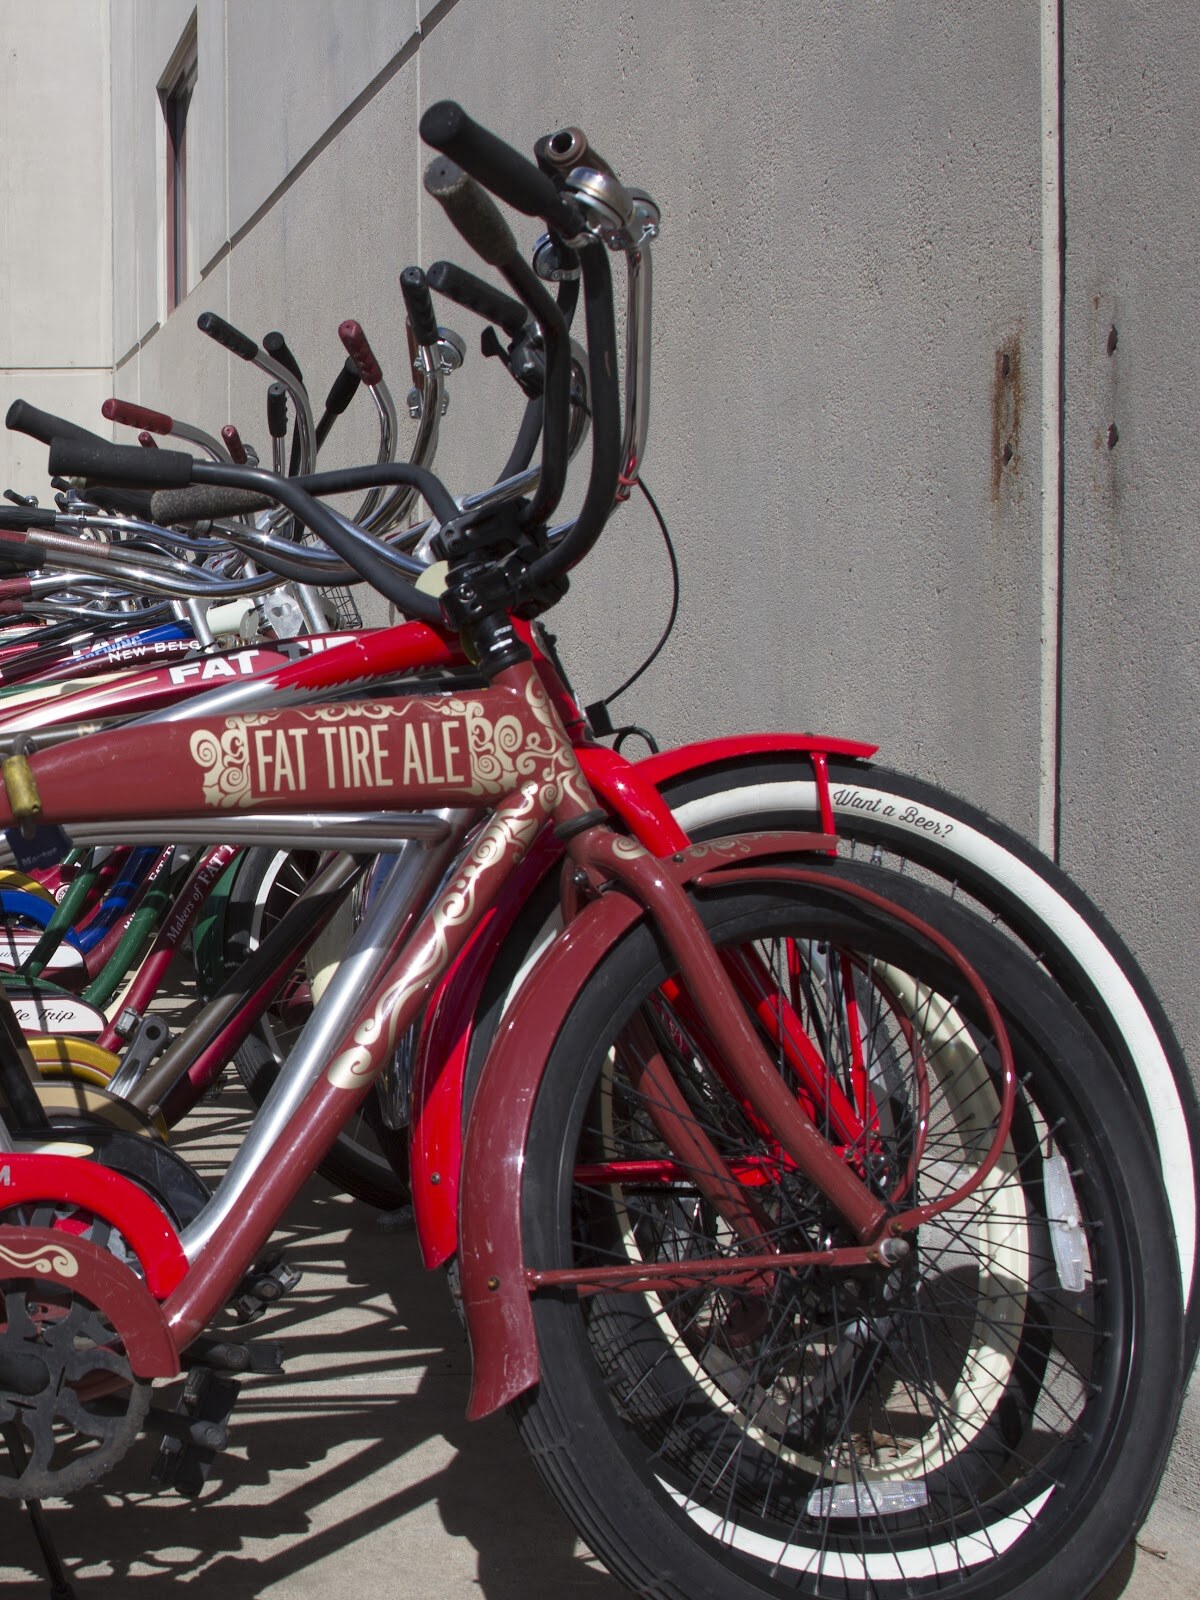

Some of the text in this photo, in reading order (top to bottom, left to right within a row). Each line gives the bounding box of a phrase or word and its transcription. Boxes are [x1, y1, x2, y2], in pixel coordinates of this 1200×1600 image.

[107, 640, 200, 663] NEW BELG
[168, 649, 260, 685] FAT
[254, 720, 465, 792] FAT TIRE ALE
[833, 788, 954, 838] Want a Beer?
[166, 852, 225, 944] Makers of FAT
[38, 1008, 76, 1024] Trip
